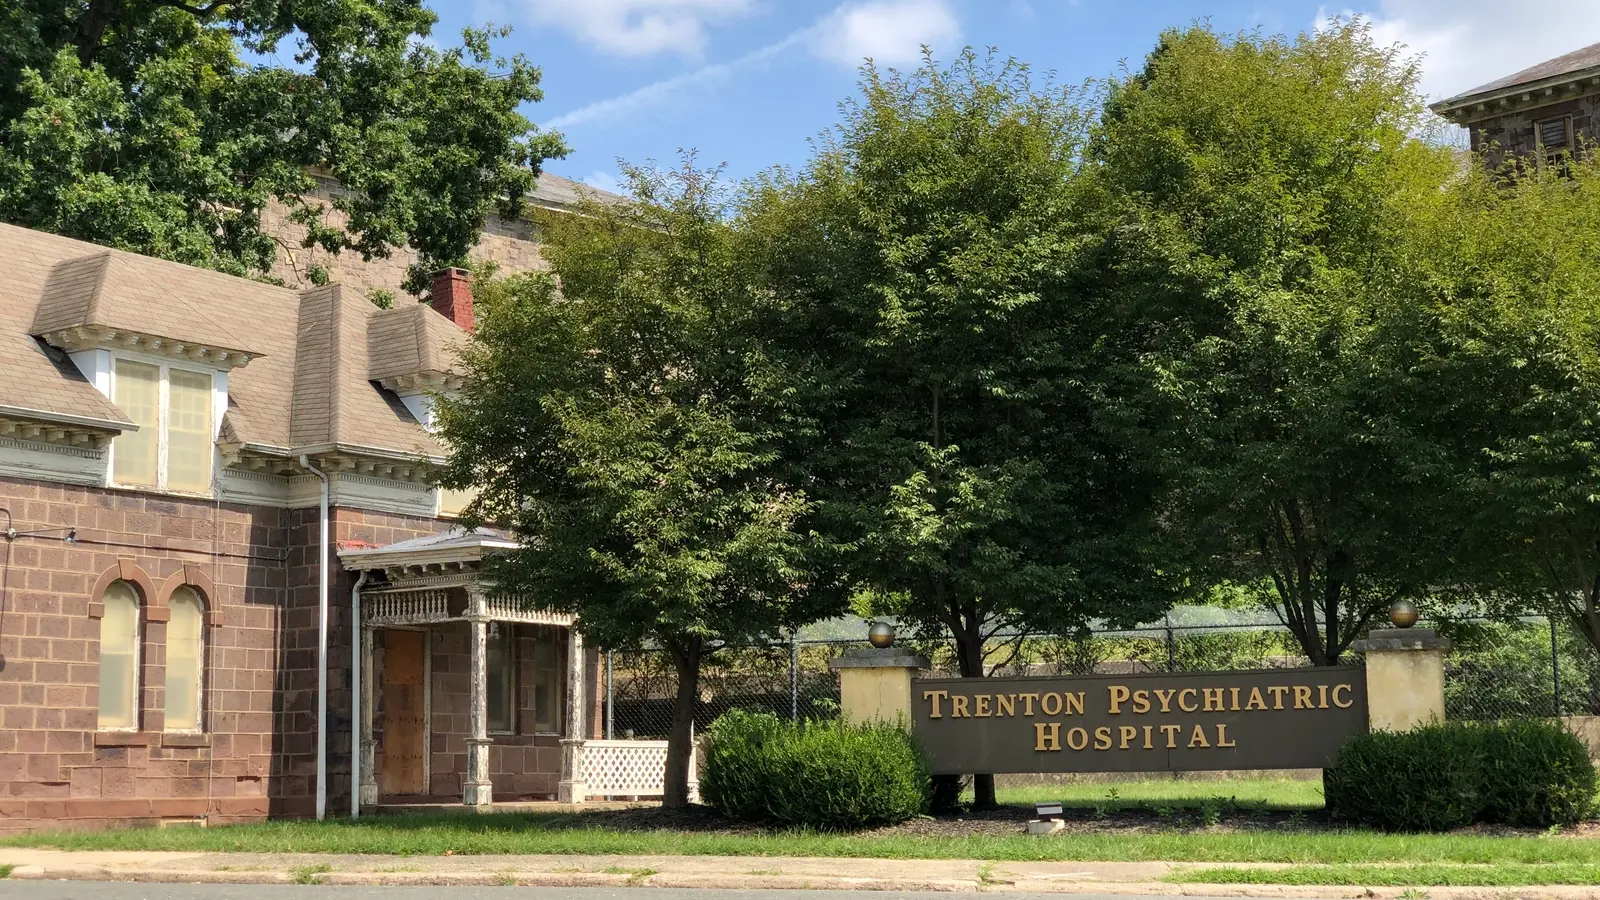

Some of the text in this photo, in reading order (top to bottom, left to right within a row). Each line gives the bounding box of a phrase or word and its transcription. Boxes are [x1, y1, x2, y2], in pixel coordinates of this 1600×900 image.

[923, 684, 1354, 718] TRENTON PSYCHIATRIC
[1034, 722, 1236, 751] HOSPITAL
